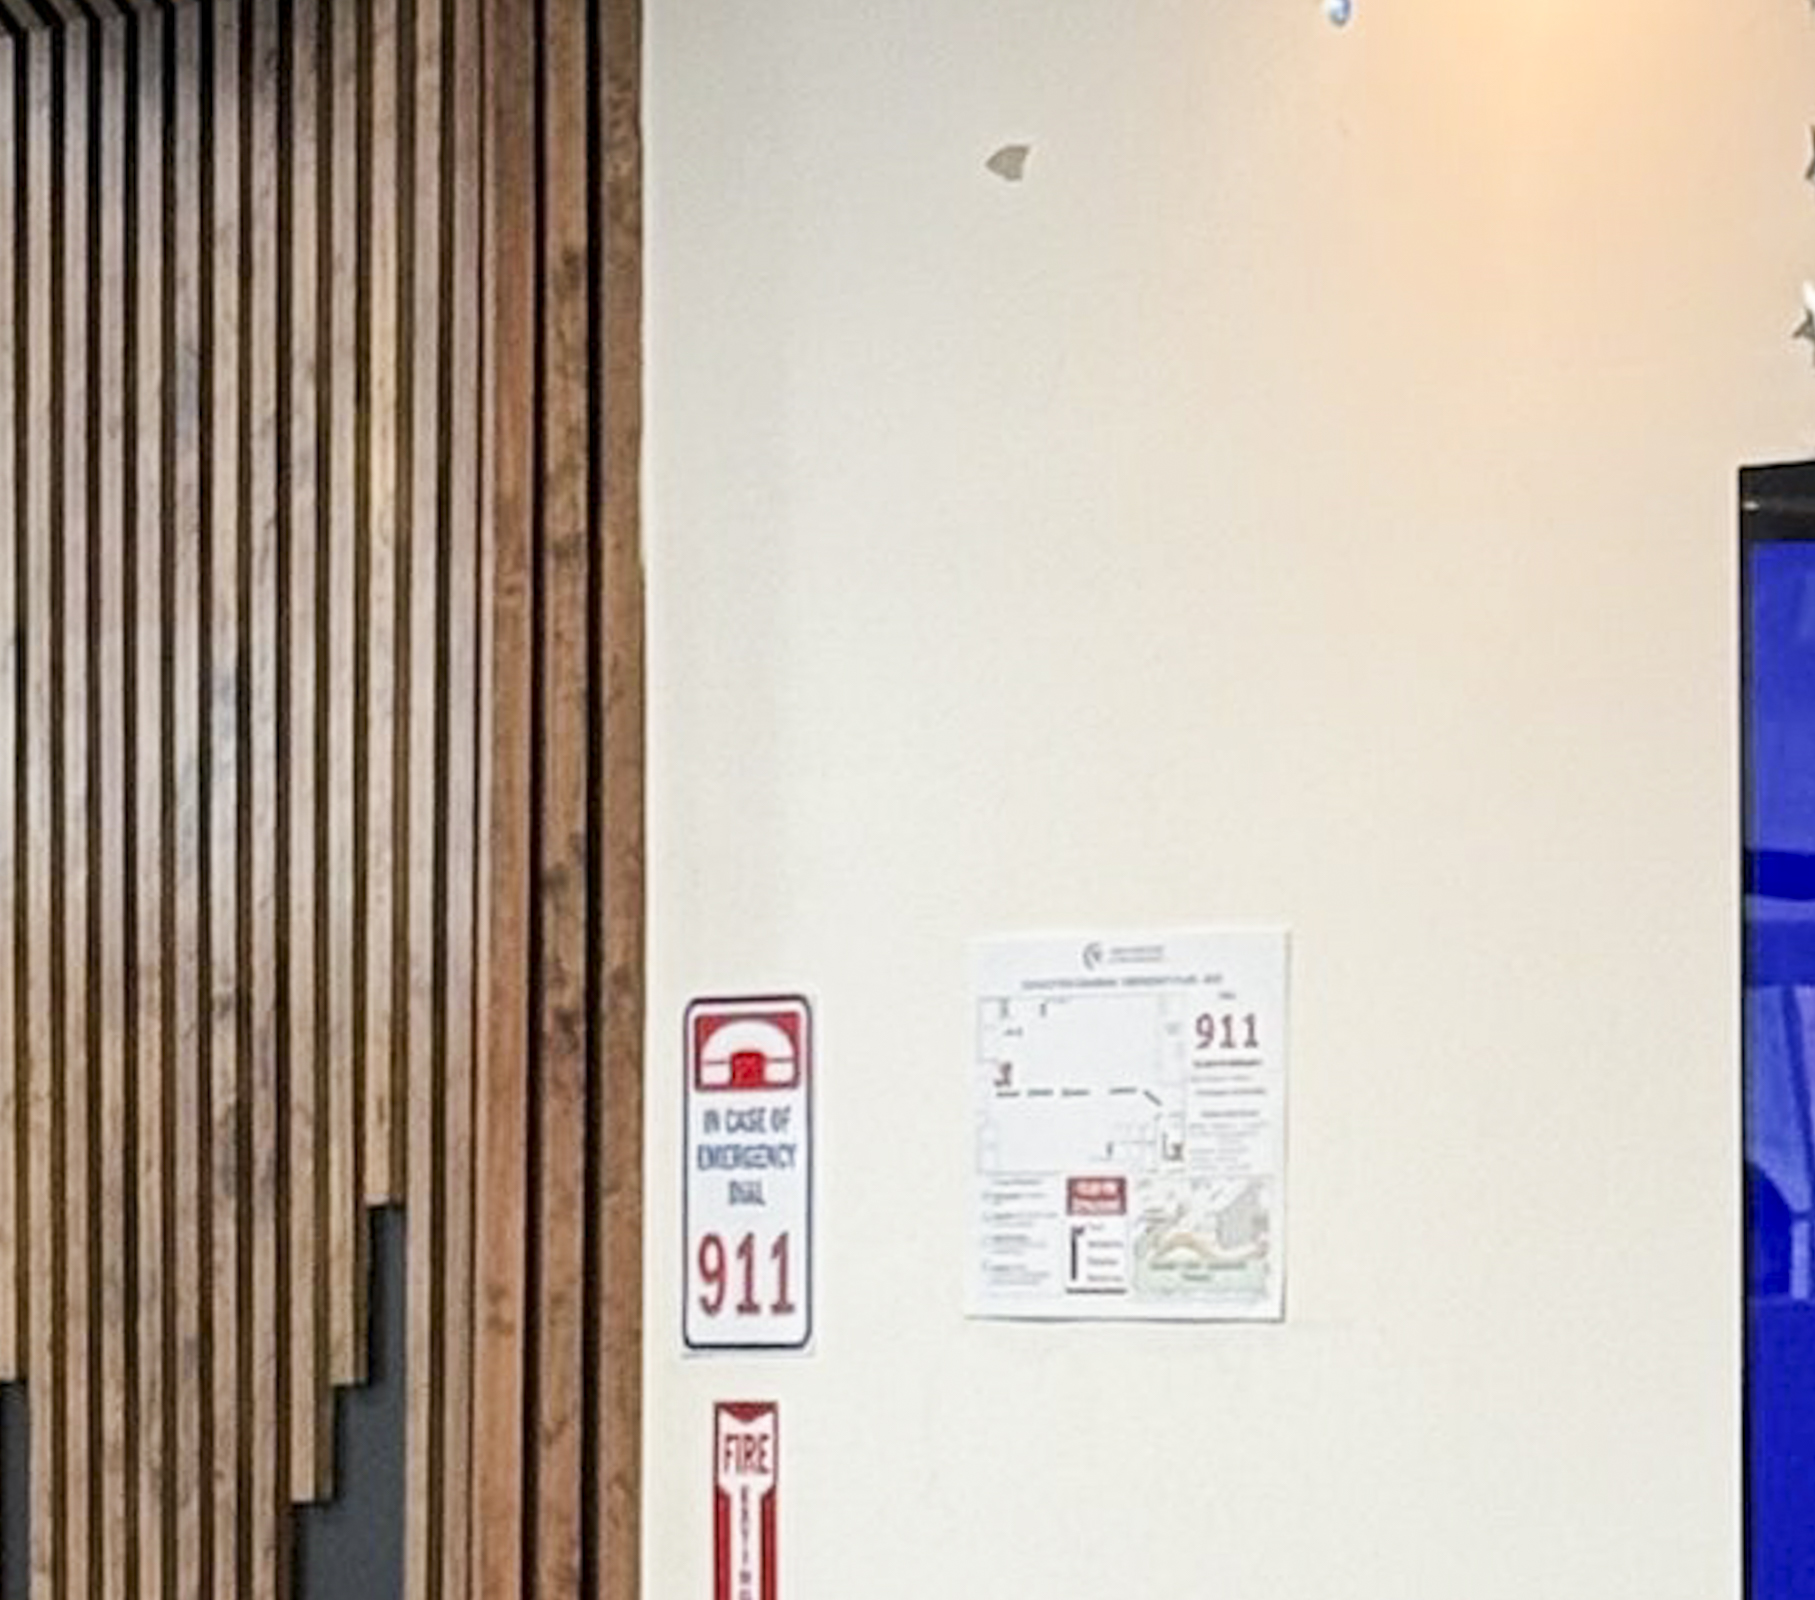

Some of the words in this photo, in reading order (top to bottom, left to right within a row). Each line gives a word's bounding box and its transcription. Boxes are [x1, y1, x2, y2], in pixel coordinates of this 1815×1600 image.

[1195, 1012, 1261, 1049] 911
[703, 1109, 720, 1133] IN
[727, 1107, 767, 1133] CASE
[771, 1105, 791, 1133] OF
[697, 1143, 797, 1170] EMERGENCY
[698, 1231, 796, 1317] 911
[723, 1433, 771, 1475] FIRE
